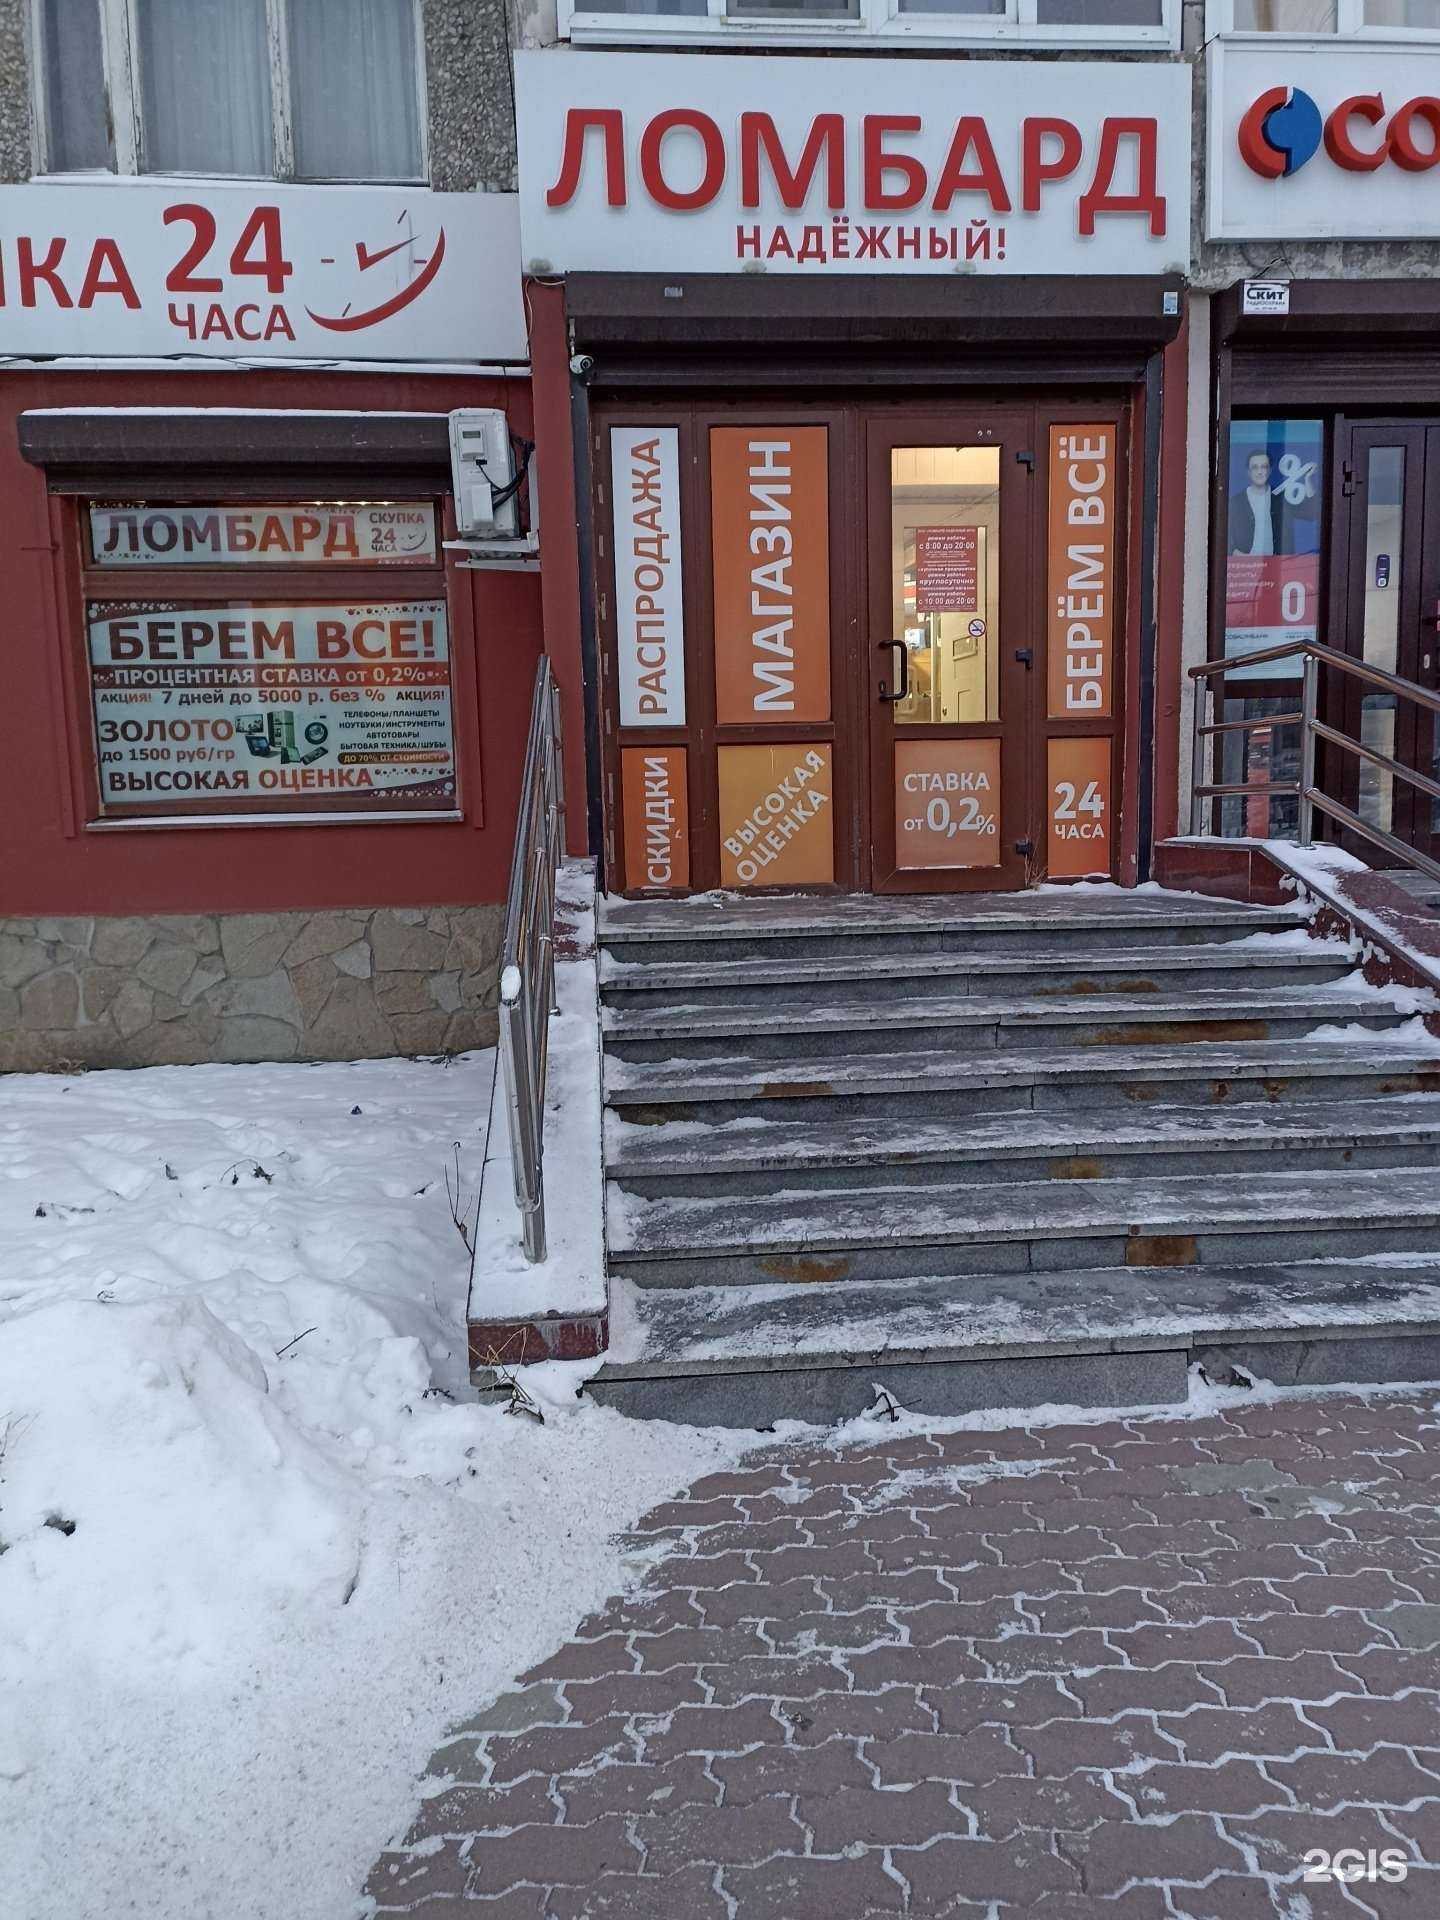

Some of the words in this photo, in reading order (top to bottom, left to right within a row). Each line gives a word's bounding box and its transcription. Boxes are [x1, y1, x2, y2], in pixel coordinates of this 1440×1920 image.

[546, 107, 1167, 236] ЛОМБАРД
[0, 237, 142, 309] КА
[163, 203, 293, 293] 24
[736, 215, 1006, 263] НАДЁЖНЫЙ!
[168, 302, 296, 341] ЧАСА
[1059, 435, 1106, 525] ВСЁ
[104, 514, 359, 558] ЛОМБАРД
[369, 511, 425, 524] СКУПКА
[371, 527, 397, 544] 24
[371, 543, 398, 553] ЧАСА
[630, 437, 669, 715] РАСПРОДАЖА
[748, 441, 794, 712] МАГАЗИН
[108, 620, 296, 661] БЕРЕМ
[316, 619, 435, 660] ВСЕ!
[1057, 544, 1104, 709] БЕРЁМ
[114, 669, 255, 686] ПРОЦЕНТНАЯ
[261, 668, 341, 684] СТАВКА
[345, 671, 367, 683] от
[373, 666, 426, 685] 0,2%
[101, 693, 152, 704] АКЦИЯ!
[162, 690, 173, 704] 7
[178, 689, 225, 706] дней
[229, 693, 252, 706] до
[258, 689, 302, 704] 5000
[308, 693, 324, 706] р.
[329, 688, 360, 703] без
[396, 690, 445, 702] АКЦИЯ!
[344, 710, 440, 718] ТЕЛЕФОНЫ/ПЛАНШЕТЫ
[100, 719, 234, 743] ЗОЛОТО
[339, 720, 445, 729] НОУТБУКИ/ИНСТРУМЕНТЫ
[366, 731, 420, 739] АВТОТОВАРЫ
[101, 751, 123, 763] до
[129, 748, 171, 761] 1500
[176, 747, 236, 763] руб/гр
[340, 742, 379, 750] БЫТОВАЯ
[109, 770, 249, 791] ВЫСОКАЯ
[258, 767, 374, 791] ОЦЕНКА
[903, 772, 991, 792] СТАВКА
[643, 756, 675, 883] СКИДКИ
[722, 750, 826, 858] ВЫСОКАЯ
[904, 817, 923, 831] от
[926, 796, 997, 838] 0,2%
[1054, 780, 1105, 820] 24
[736, 789, 830, 881] ОЦЕНКА
[1054, 823, 1105, 840] ЧАСА
